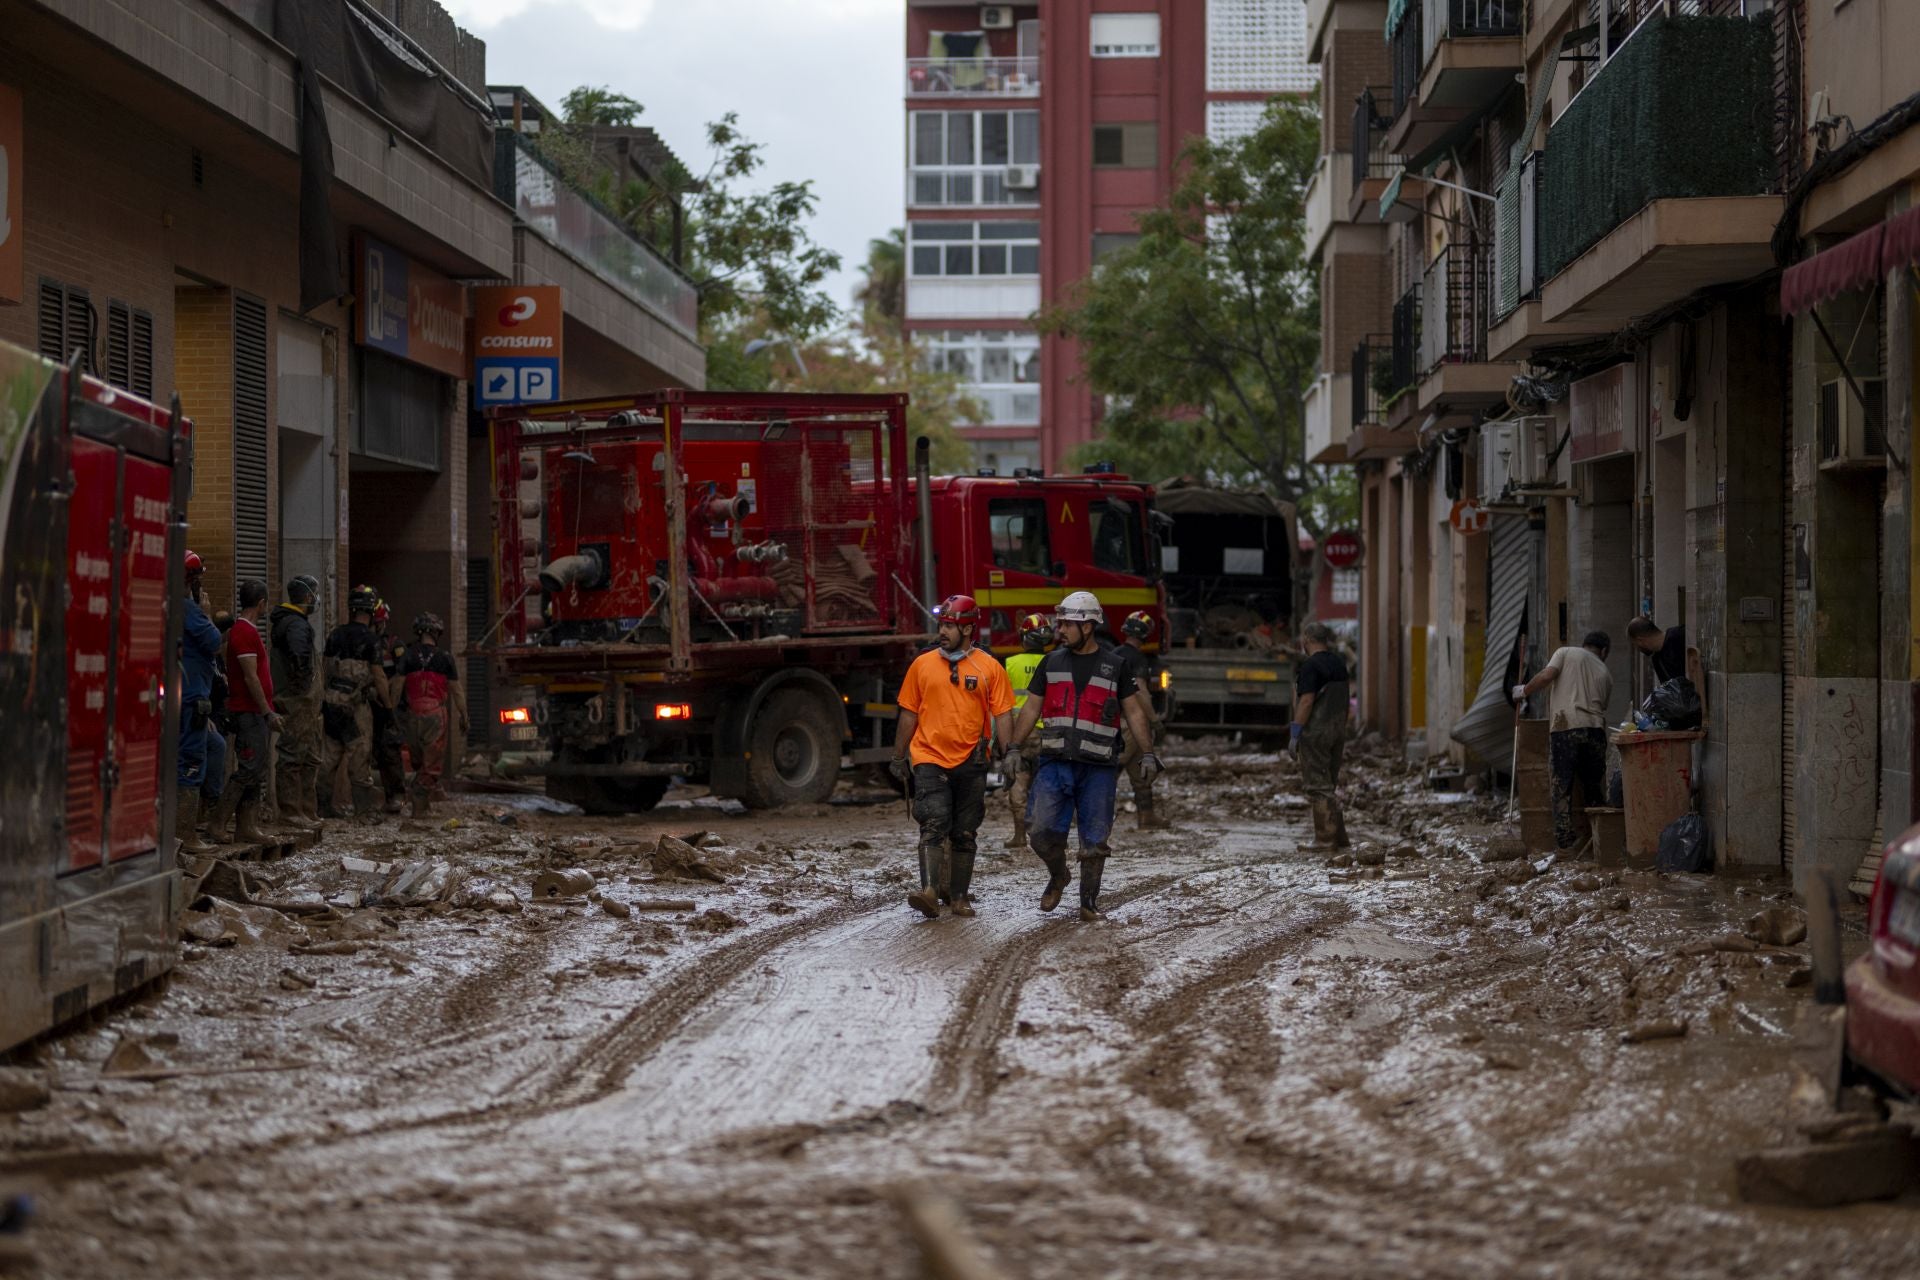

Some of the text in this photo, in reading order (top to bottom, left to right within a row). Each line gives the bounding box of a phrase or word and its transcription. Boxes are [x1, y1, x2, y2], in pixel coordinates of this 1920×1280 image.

[480, 335, 554, 348] consum
[527, 372, 544, 395] P
[1326, 544, 1358, 556] STOP
